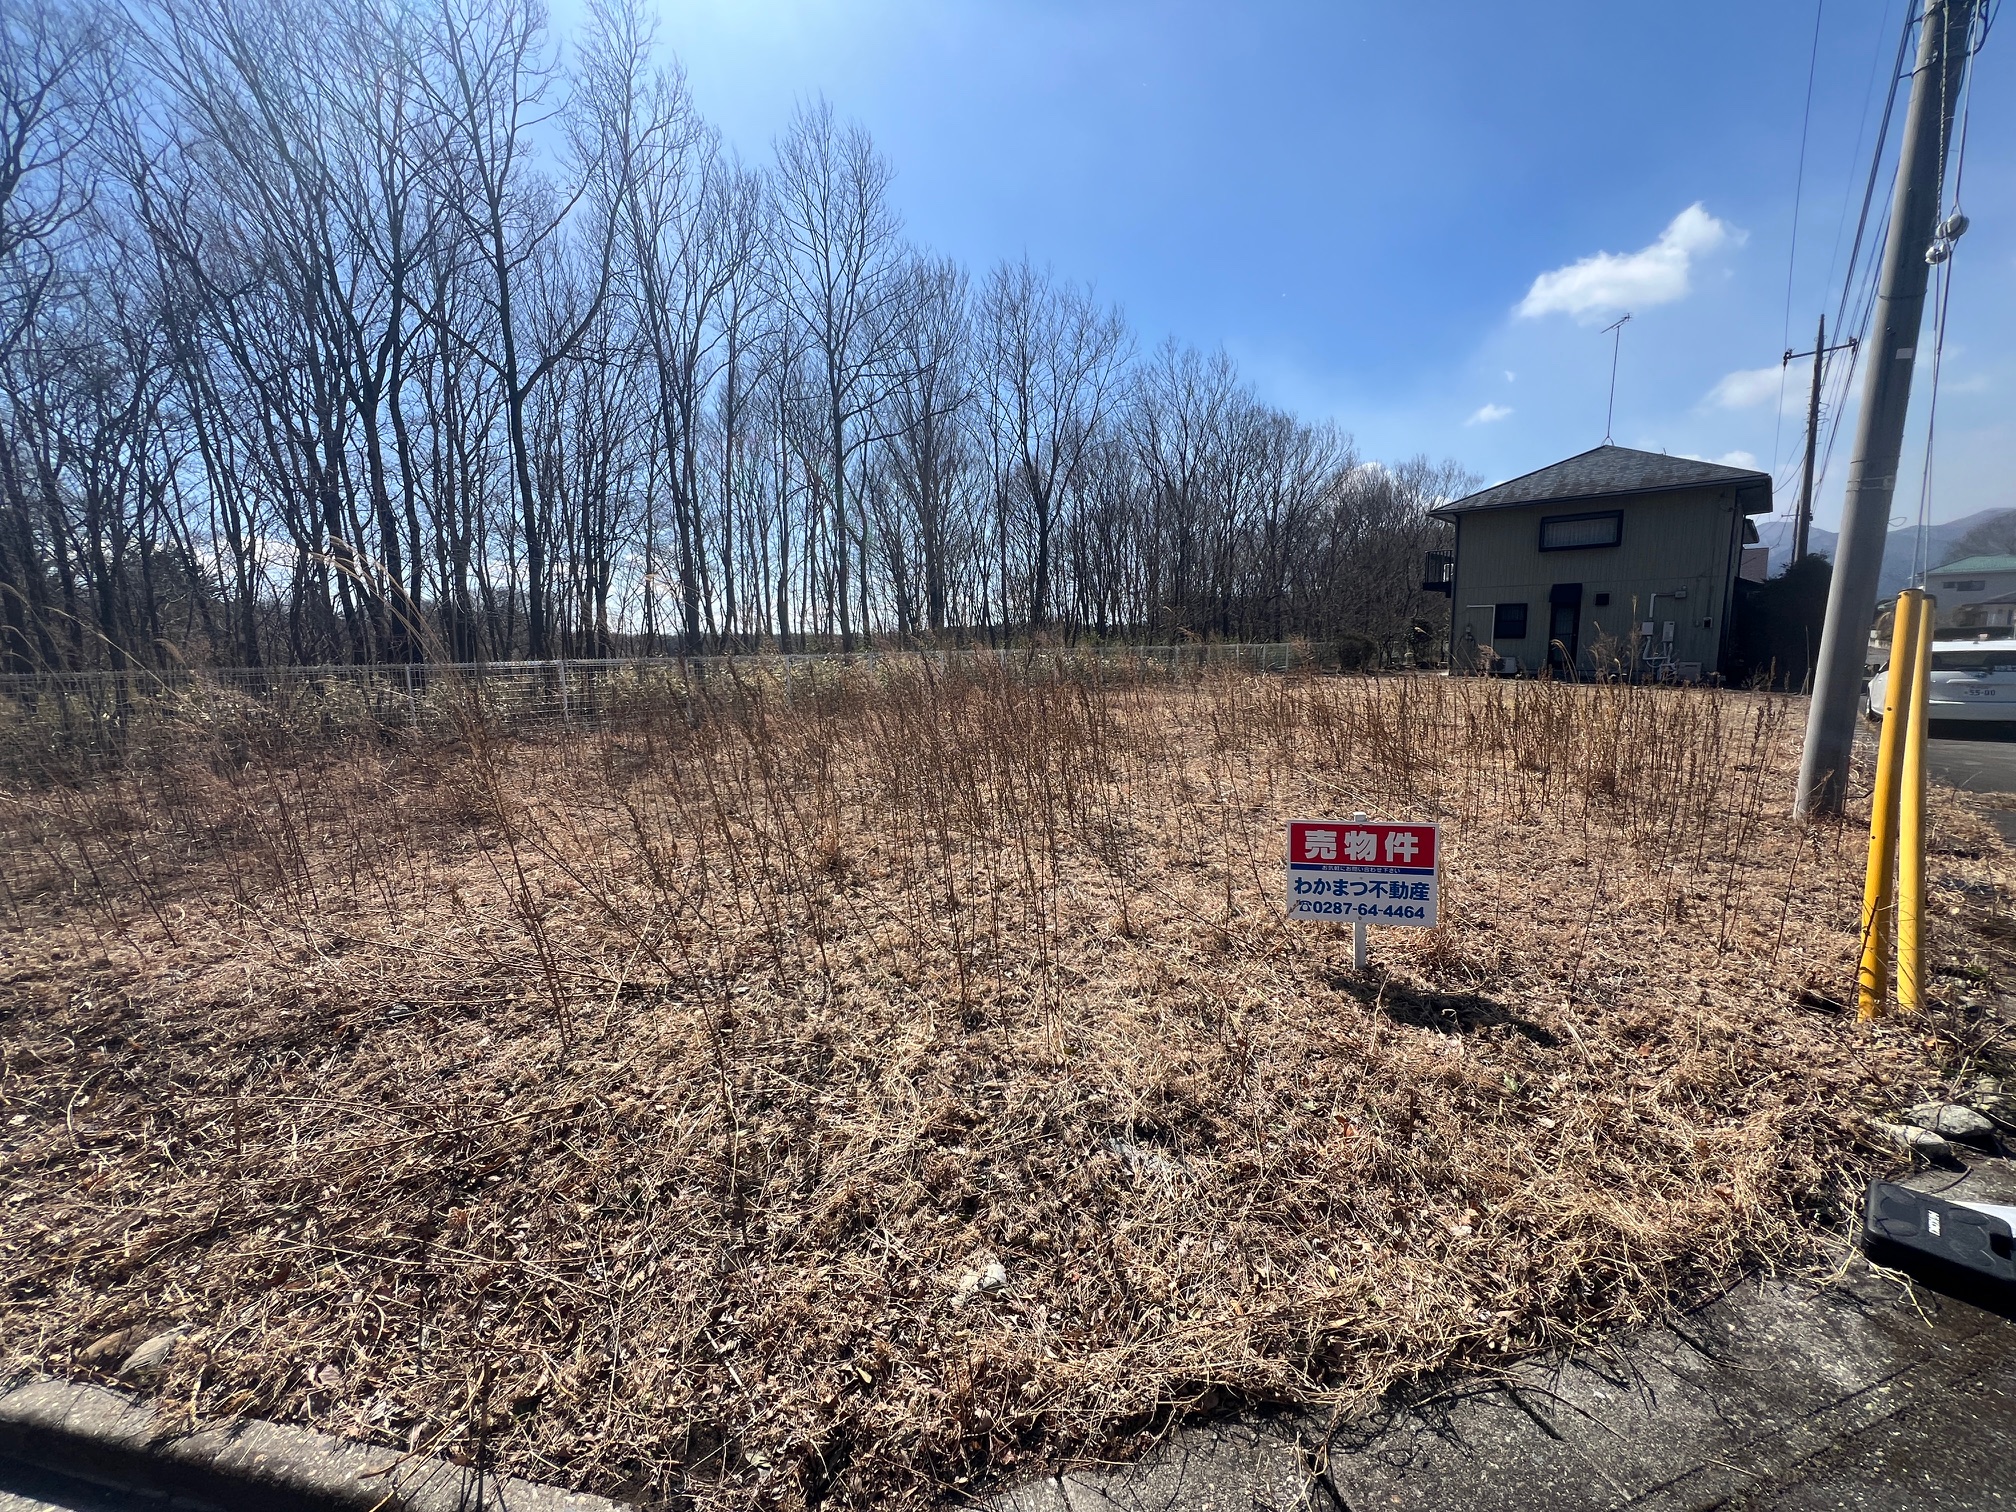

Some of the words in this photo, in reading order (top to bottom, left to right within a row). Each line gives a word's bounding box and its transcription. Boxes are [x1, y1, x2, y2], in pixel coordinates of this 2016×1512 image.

[1304, 829, 1419, 863] 売物件
[1293, 877, 1430, 901] わかまつ不動産
[1312, 901, 1425, 919] 0287-64-4464
